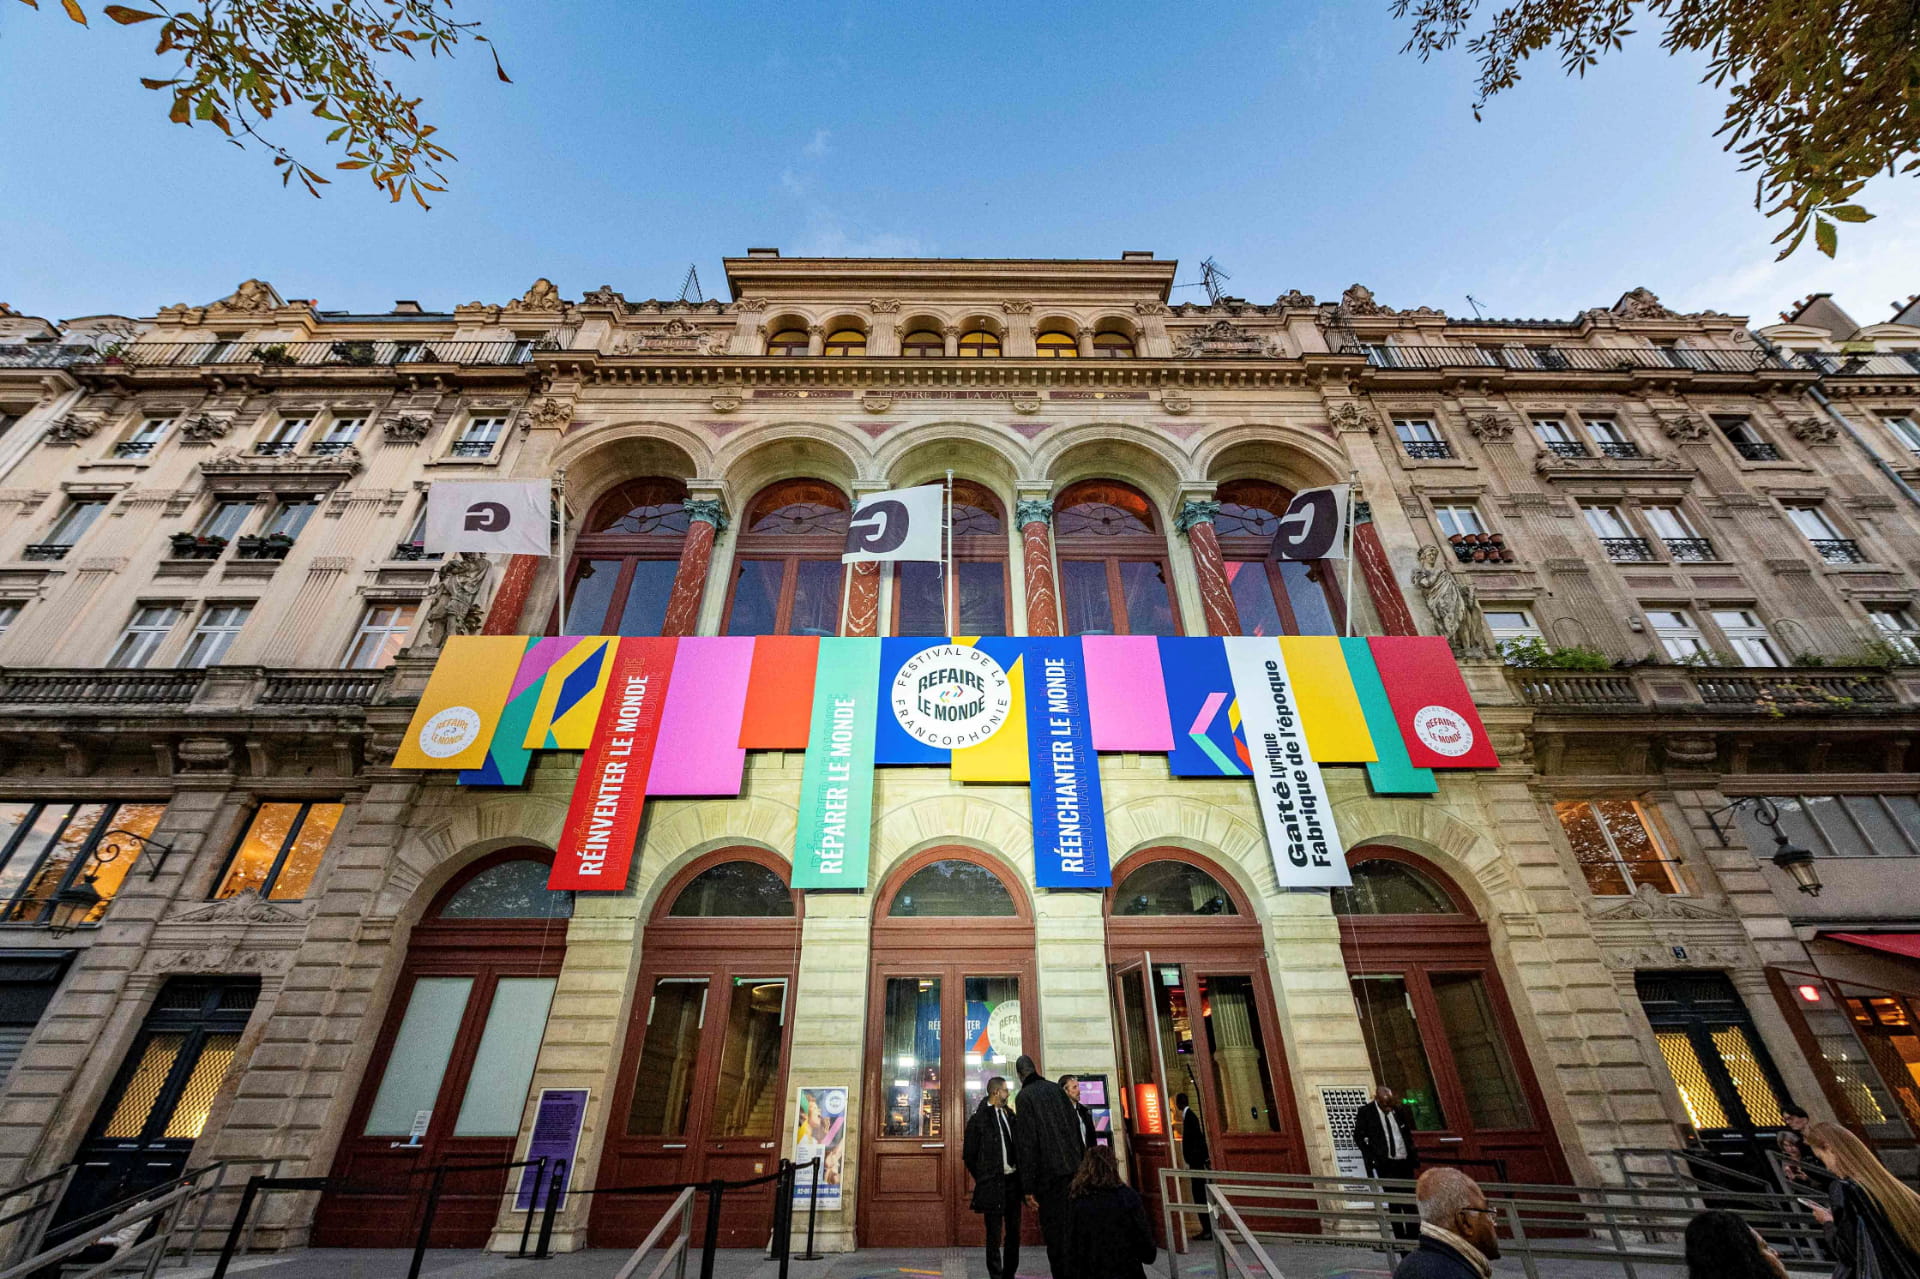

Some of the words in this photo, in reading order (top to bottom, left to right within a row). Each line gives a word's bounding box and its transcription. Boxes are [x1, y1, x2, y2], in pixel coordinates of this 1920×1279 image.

[940, 391, 956, 399] DE
[966, 391, 982, 399] LA
[897, 647, 962, 687] FESTIVAL
[970, 651, 991, 667] DE
[991, 669, 1006, 687] LA
[918, 667, 985, 694] REFAIRE
[1044, 658, 1070, 713] MONDE
[1266, 660, 1298, 739] l'époque
[615, 675, 649, 732] MONDE
[895, 698, 1008, 746] FRANCOPHONIE
[918, 695, 931, 718] LE
[934, 694, 985, 722] MONDE
[436, 718, 468, 731] REFAIRE
[438, 734, 464, 745] MONDE
[830, 698, 856, 757] MONDE
[1049, 717, 1072, 736] LE
[1426, 717, 1459, 731] REFAIRE
[1438, 729, 1462, 744] MONDE
[609, 737, 634, 756] LE
[1263, 733, 1288, 779] Lyrique
[1285, 741, 1304, 767] de
[827, 761, 851, 782] LE
[579, 761, 628, 875] RÉINVENTER
[1052, 741, 1085, 873] RÉENCHANTER
[1273, 781, 1308, 868] Gaîté
[1293, 770, 1333, 867] Fabrique
[815, 787, 849, 874] RÉPARER
[1676, 947, 1685, 958] 5
[1322, 1089, 1339, 1139] OUVERT
[1328, 1089, 1345, 1139] OUVERT
[1334, 1089, 1351, 1139] OUVERT
